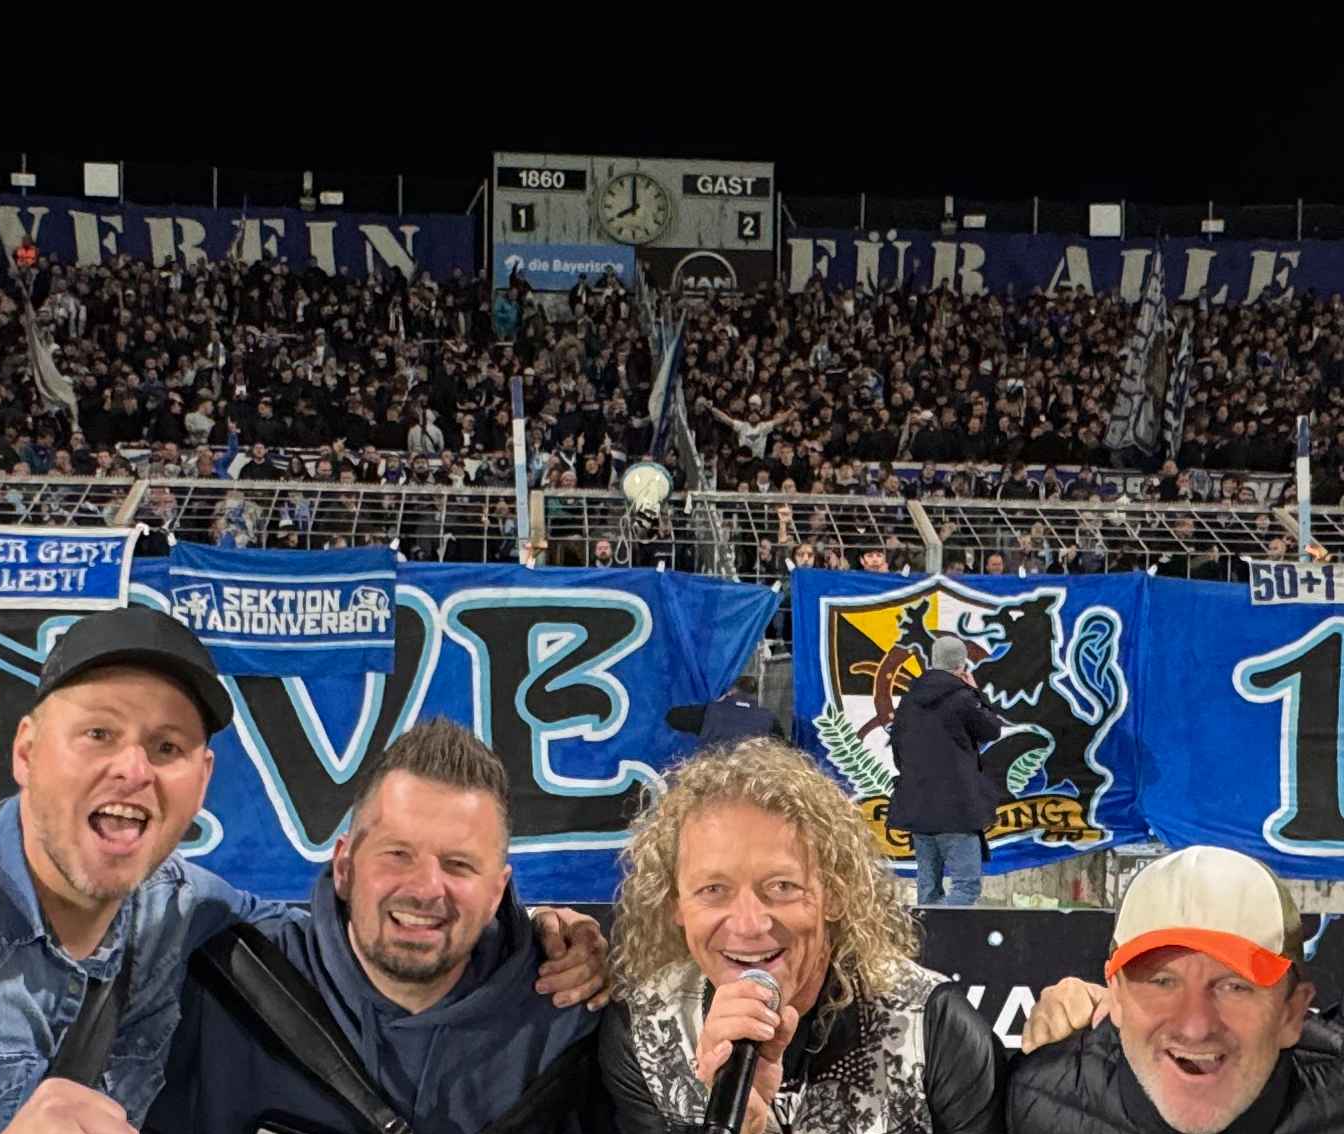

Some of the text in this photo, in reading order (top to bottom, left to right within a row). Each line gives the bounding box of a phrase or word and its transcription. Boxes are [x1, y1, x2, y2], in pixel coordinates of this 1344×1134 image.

[519, 171, 565, 190] 1860
[696, 175, 756, 196] GAST
[517, 207, 527, 228] 1
[742, 216, 755, 237] 2
[786, 228, 990, 297] FÜR
[1047, 246, 1302, 305] ALLE
[1253, 562, 1337, 602] 50+1
[222, 586, 342, 613] SEKTION
[171, 605, 392, 636] STADIONVERBOT
